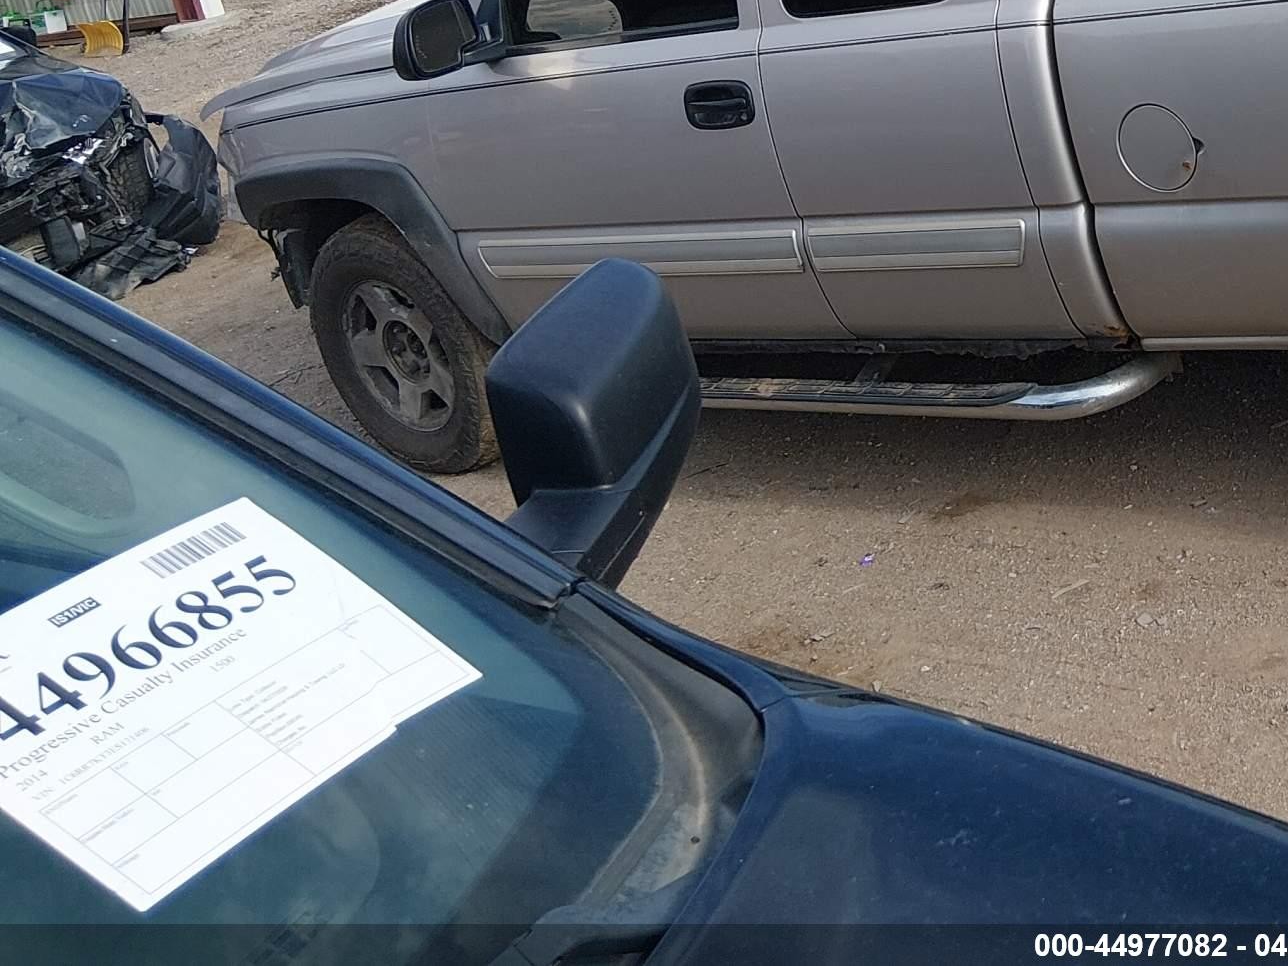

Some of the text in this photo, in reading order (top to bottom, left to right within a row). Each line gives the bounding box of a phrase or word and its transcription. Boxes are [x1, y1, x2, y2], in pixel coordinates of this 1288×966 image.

[0, 555, 297, 742] 44966855
[0, 628, 247, 780] Progressive Casualty Insurance
[16, 655, 237, 792] 2014 RAM 1500
